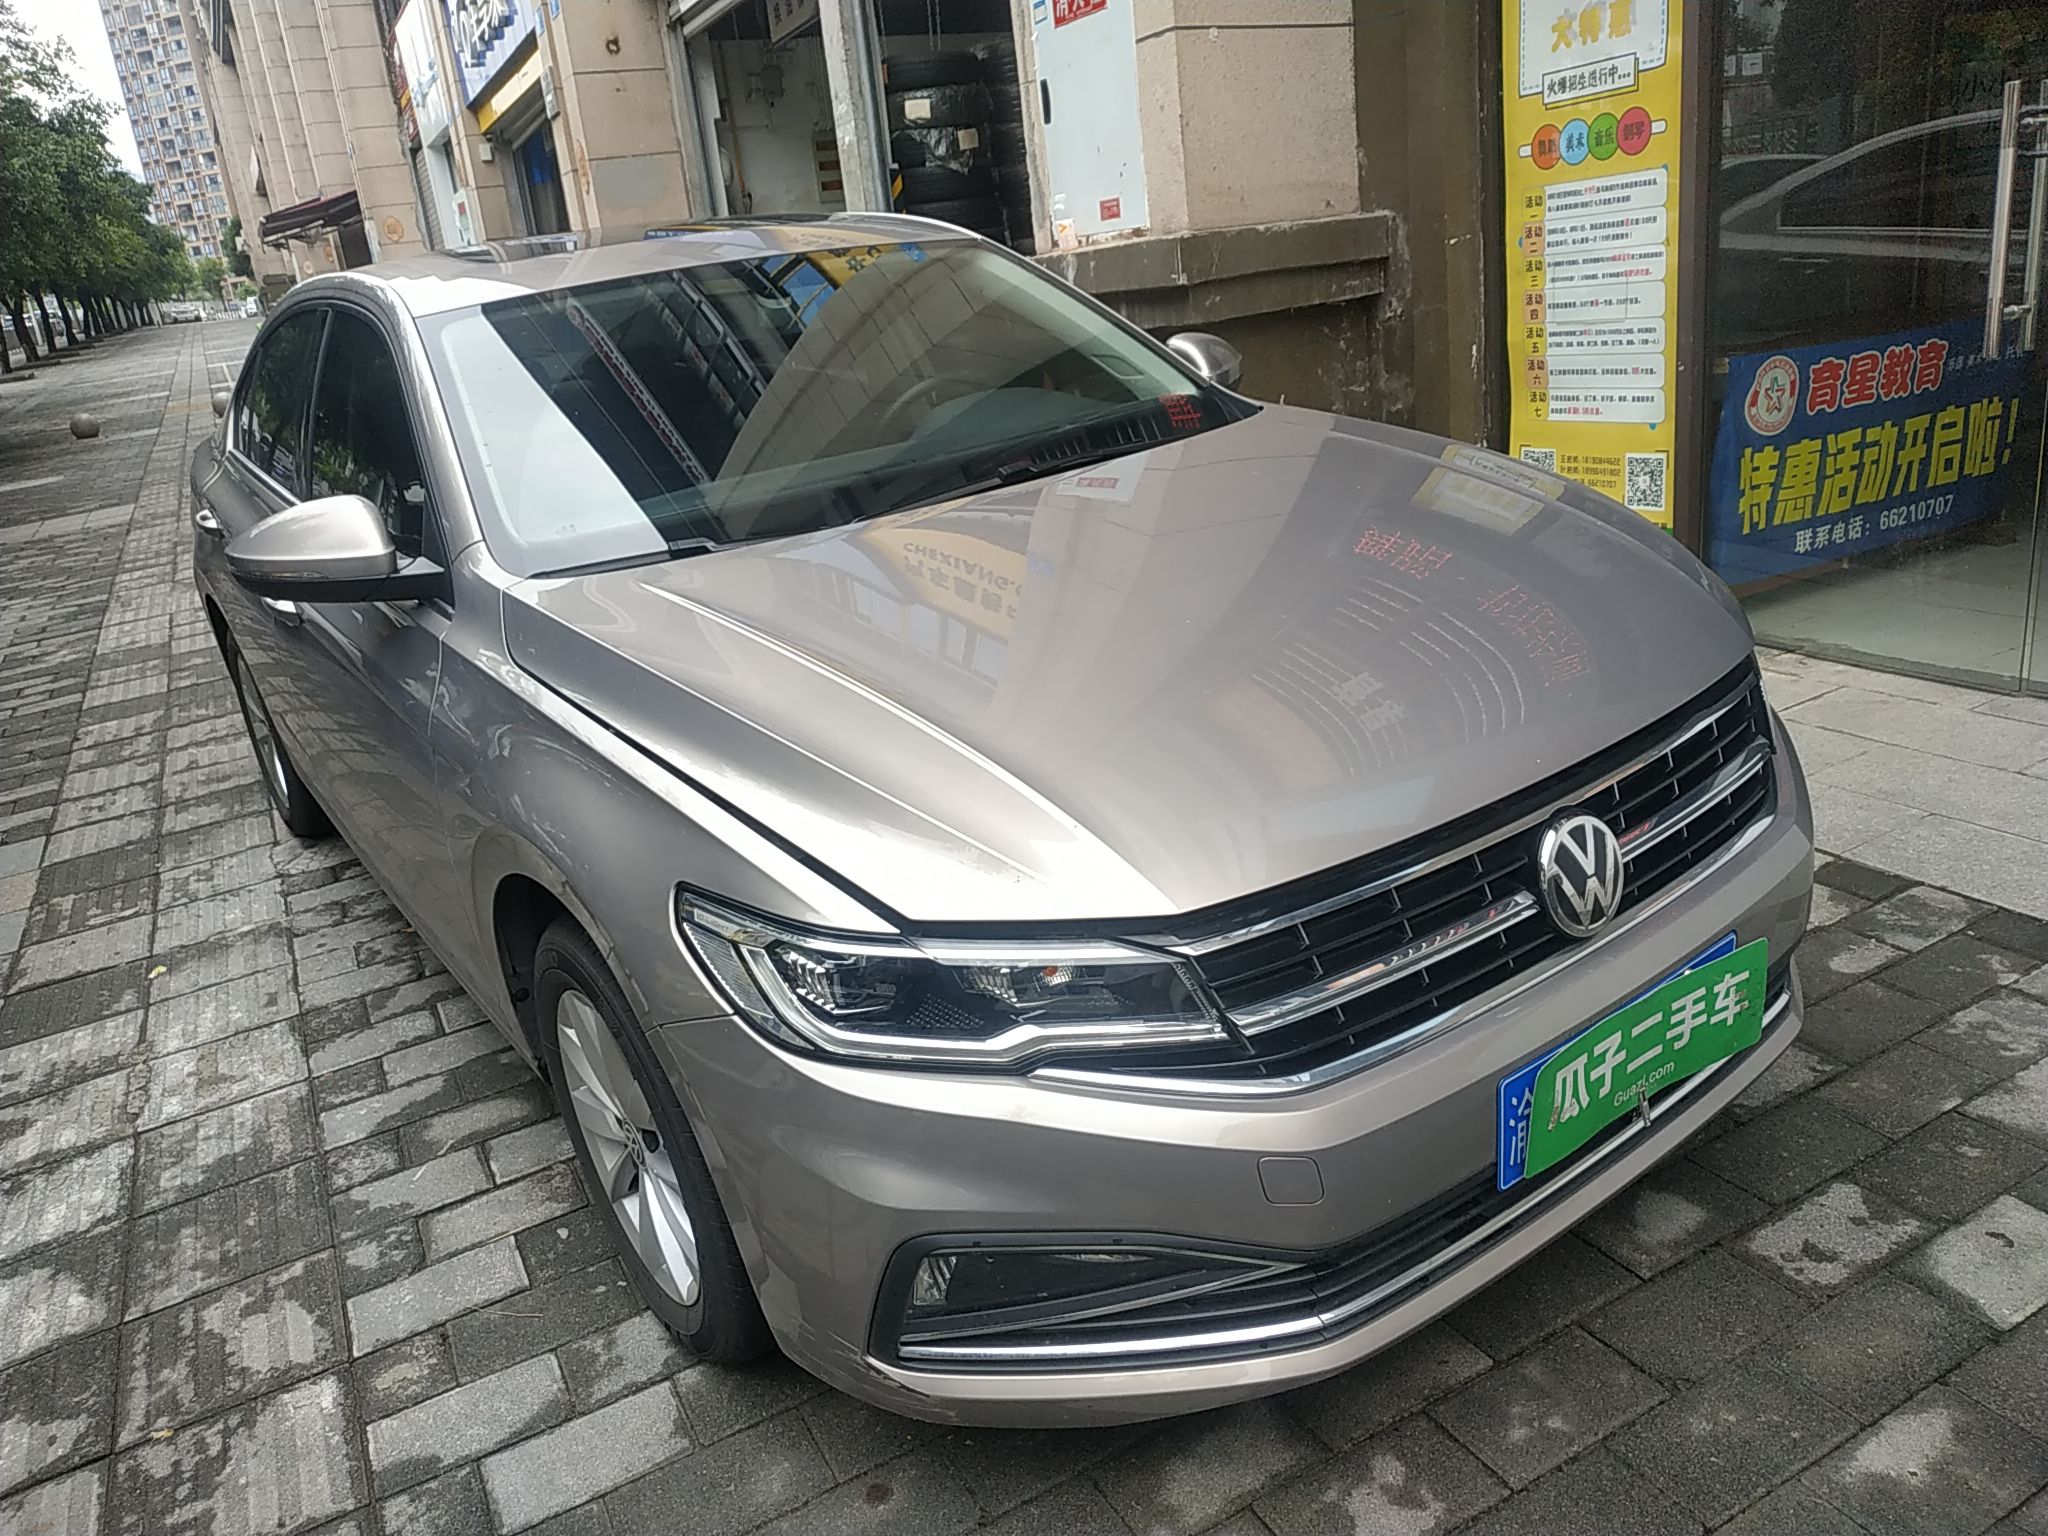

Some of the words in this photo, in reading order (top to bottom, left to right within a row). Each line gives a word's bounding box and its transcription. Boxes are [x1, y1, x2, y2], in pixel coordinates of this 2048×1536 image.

[1566, 132, 1585, 153] 美术
[1593, 126, 1615, 147] 音乐
[1806, 337, 1949, 416] 育星教育
[1738, 396, 2020, 536] 特惠活动开启啦！
[1547, 970, 1750, 1132] 瓜子二手车
